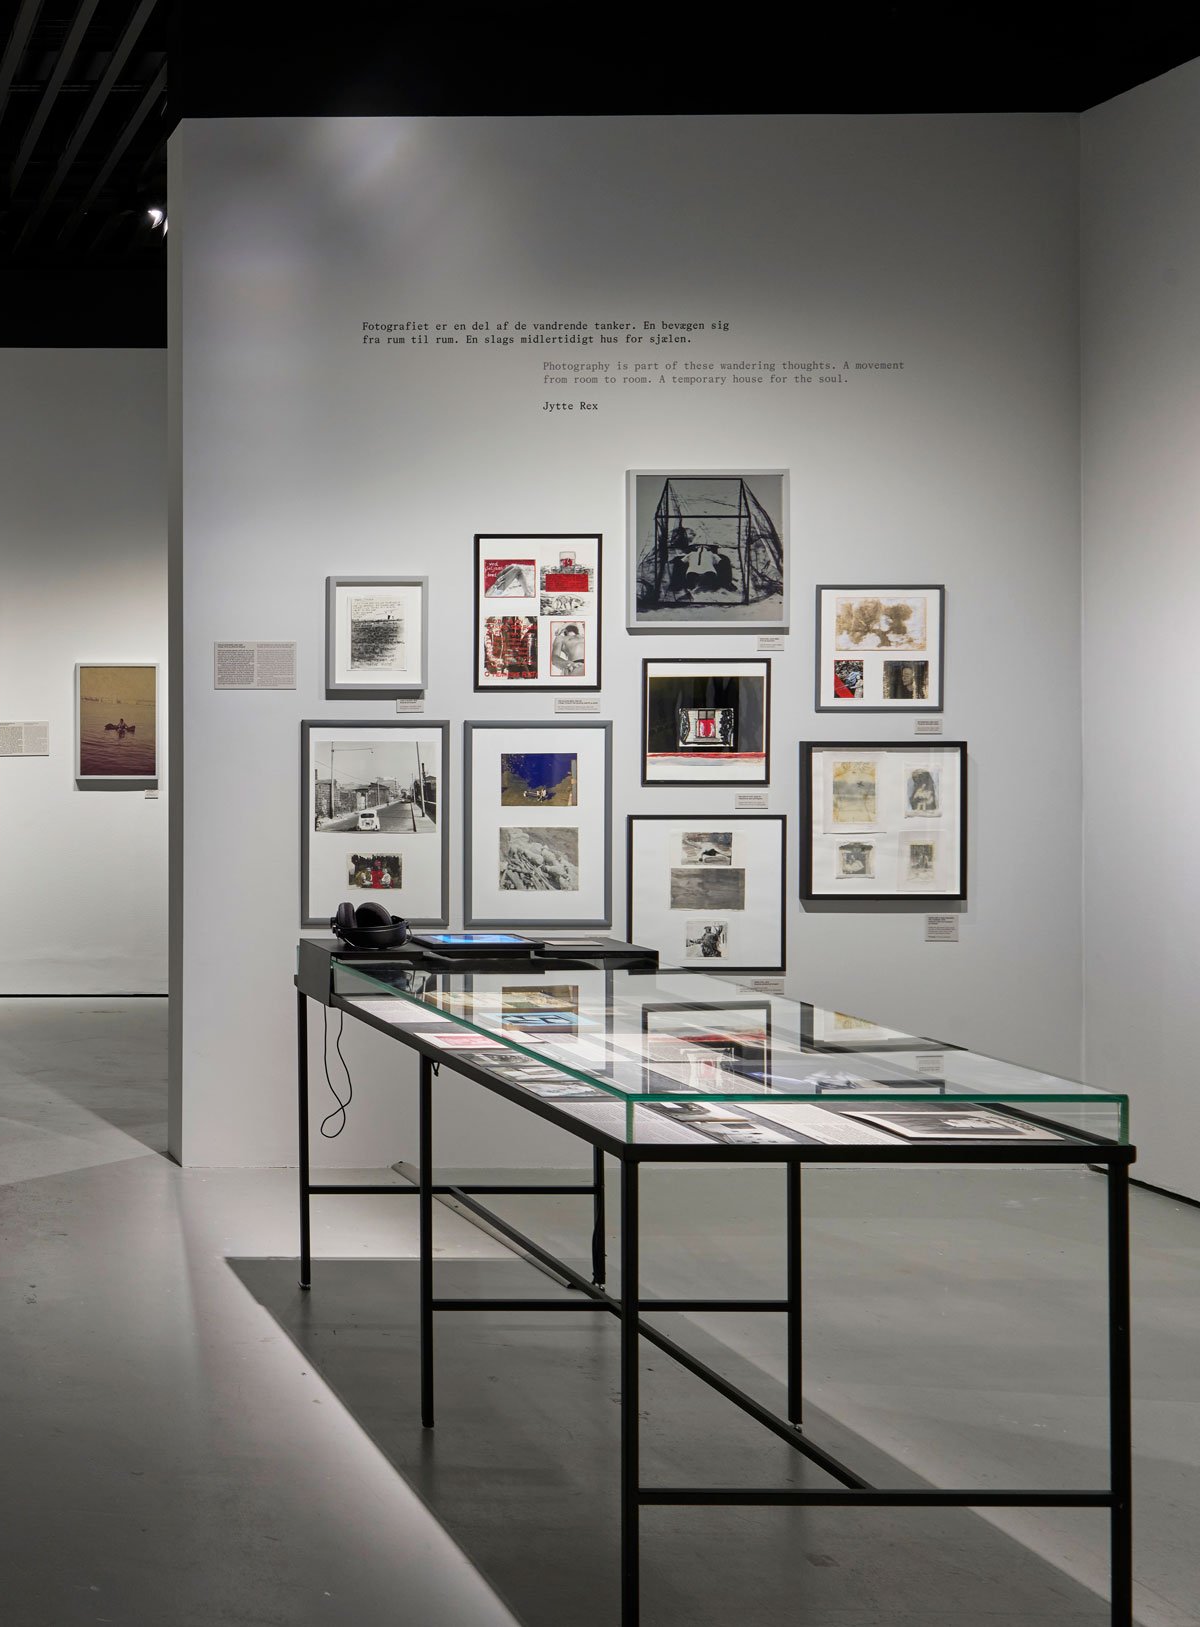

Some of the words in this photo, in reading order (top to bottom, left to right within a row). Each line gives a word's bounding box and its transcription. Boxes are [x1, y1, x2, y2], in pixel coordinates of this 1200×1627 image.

[362, 321, 429, 333] Fotografiet
[435, 323, 448, 331] er
[472, 321, 490, 331] del
[497, 321, 509, 330] af
[515, 321, 526, 330] de
[533, 321, 588, 330] vandrende
[593, 321, 635, 330] tanker.
[644, 321, 655, 330] En
[662, 321, 704, 332] bevægen
[711, 321, 729, 331] sig
[363, 335, 380, 344] fra
[411, 335, 428, 344] til
[466, 335, 478, 344] En
[485, 334, 514, 346] slags
[520, 334, 593, 345] midlertidigt
[600, 334, 618, 343] hus
[625, 334, 643, 343] for
[650, 334, 691, 345] sjælen.
[543, 362, 610, 372] Photography
[618, 361, 628, 370] is
[635, 363, 659, 372] part
[665, 361, 678, 370] of
[684, 361, 714, 370] these
[720, 361, 775, 372] wandering
[782, 361, 835, 371] thoughts.
[843, 361, 850, 369] A
[544, 375, 567, 383] from
[657, 375, 665, 383] A
[672, 376, 728, 385] temporary
[733, 375, 763, 384] house
[771, 374, 787, 383] for
[794, 374, 812, 383] the
[817, 374, 847, 383] soul.
[542, 400, 573, 412] Jytte
[580, 401, 598, 412] Rex
